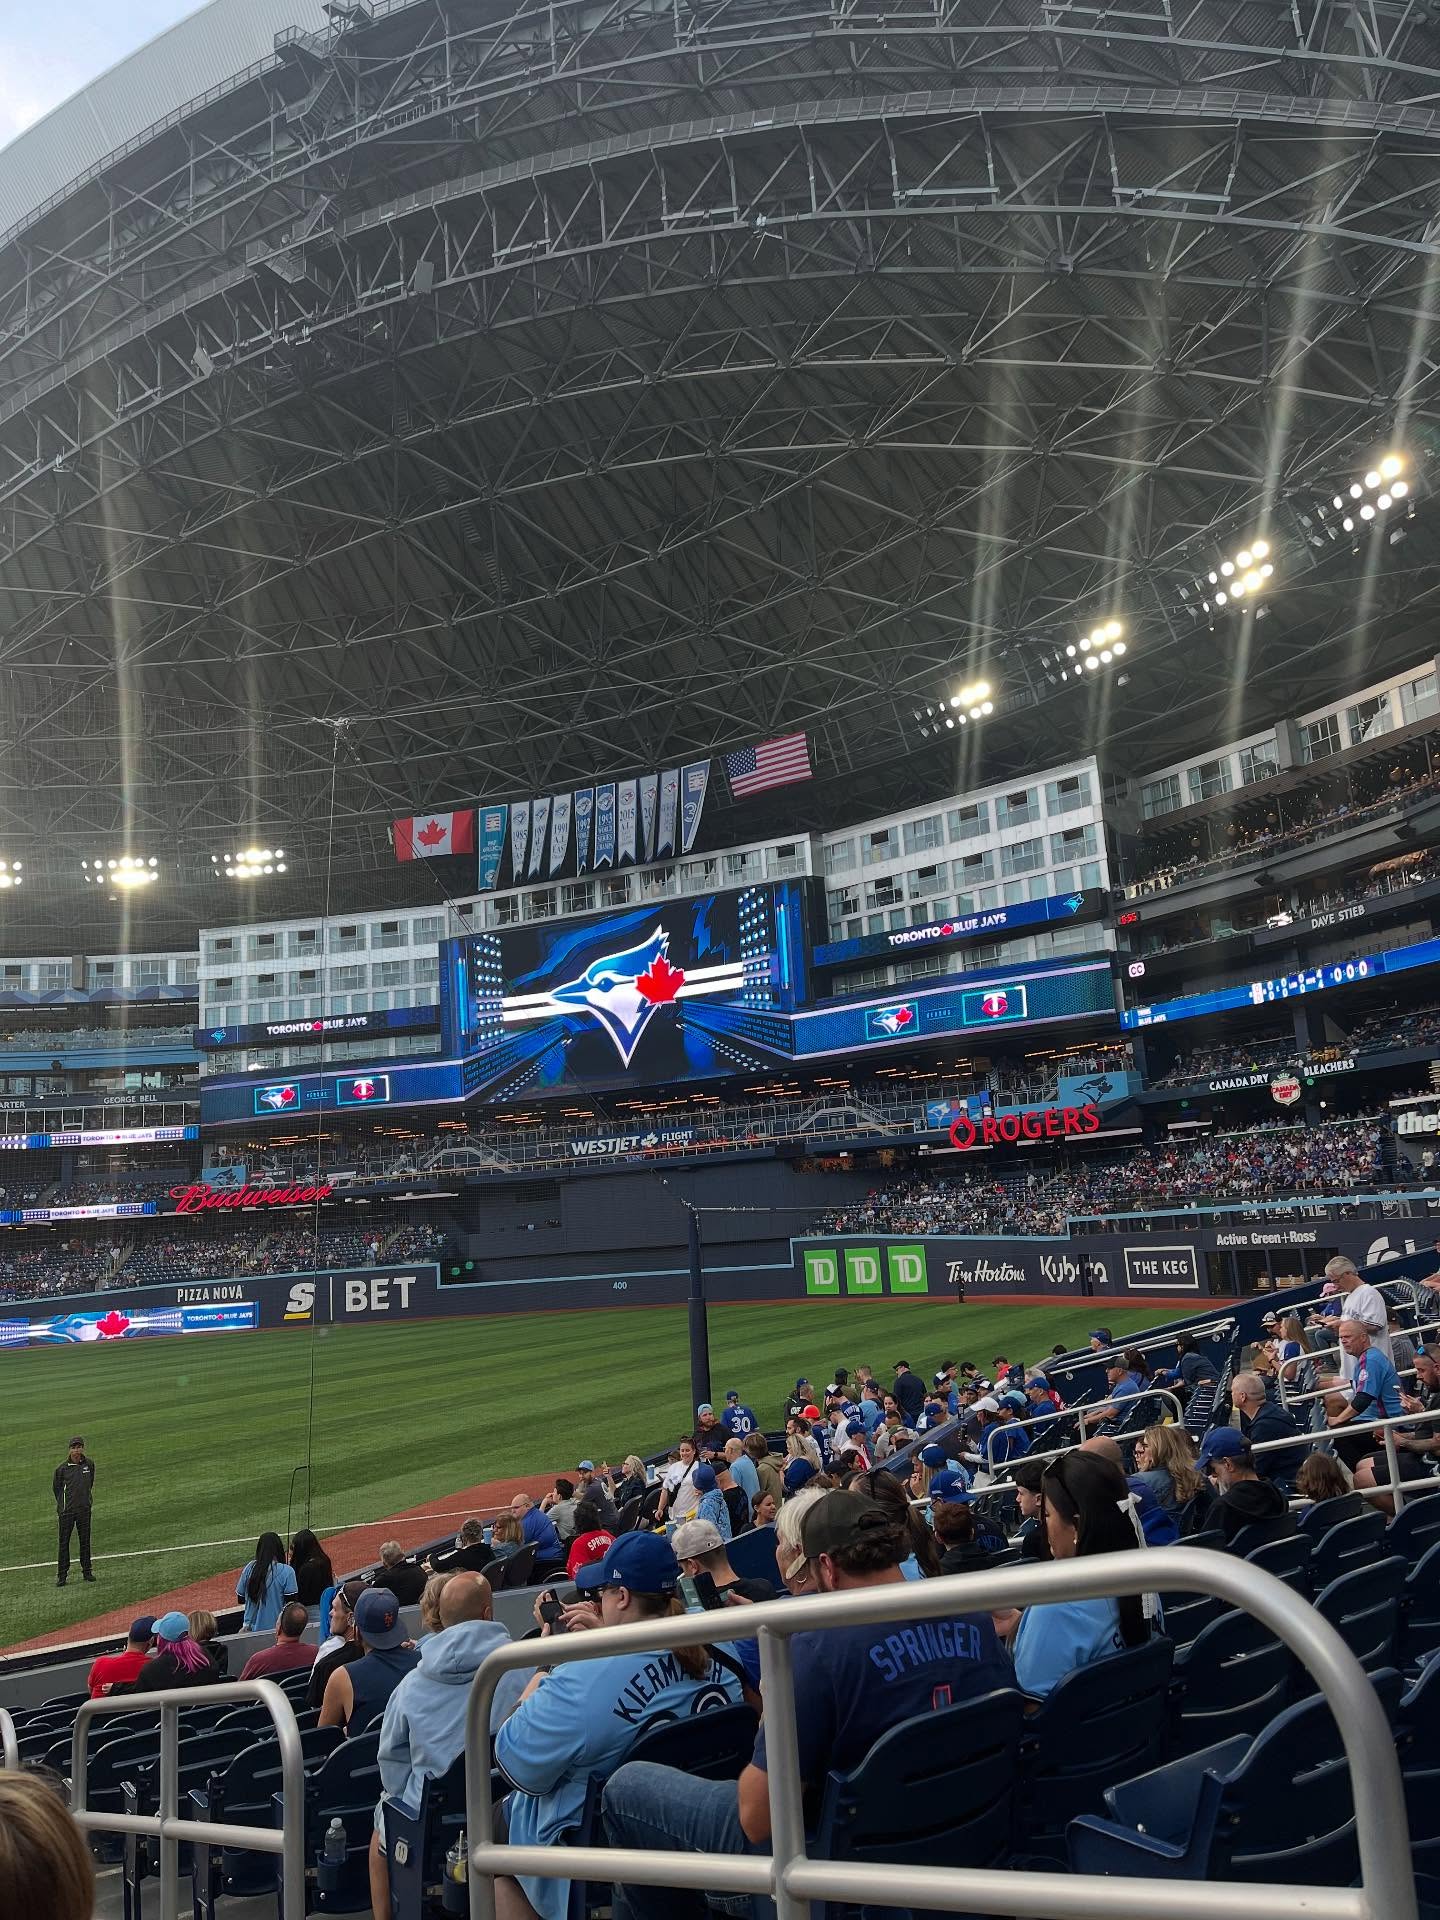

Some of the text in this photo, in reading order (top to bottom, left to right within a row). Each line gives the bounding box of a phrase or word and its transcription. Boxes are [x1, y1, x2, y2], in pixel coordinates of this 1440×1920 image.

[598, 813, 613, 825] 1993
[1312, 904, 1366, 929] DAVE STIEB
[888, 912, 1007, 946] TORONTO BLUE JAYS
[266, 1016, 367, 1036] TORONTO BLUE JAYS
[1303, 1059, 1355, 1077] BLEACHERS
[1209, 1073, 1270, 1091] CANADA DRY
[1271, 1084, 1301, 1094] CANADA
[104, 1094, 158, 1105] GEORGE BELL
[1279, 1091, 1293, 1099] DRY
[983, 1104, 1099, 1143] ROGERS
[1397, 1110, 1440, 1135] the
[571, 1136, 640, 1156] WESTJET
[661, 1130, 694, 1142] FLIGHT
[169, 1181, 333, 1213] Budweiser
[1216, 1230, 1317, 1246] Active Green+Ross
[808, 1258, 834, 1285] TD
[848, 1256, 877, 1284] TD
[892, 1254, 923, 1283] TD
[946, 1259, 1026, 1283] Tim Hortons
[1039, 1255, 1109, 1283] Kuba
[1133, 1260, 1188, 1275] THE KEG
[177, 1284, 243, 1303] PIZZA NOVA
[285, 1276, 417, 1313] S BET
[613, 1281, 628, 1290] 400
[187, 1314, 217, 1322] TORONTO
[238, 1311, 253, 1320] JAYS
[731, 1416, 751, 1433] 30
[869, 1622, 981, 1682] SPRINGER
